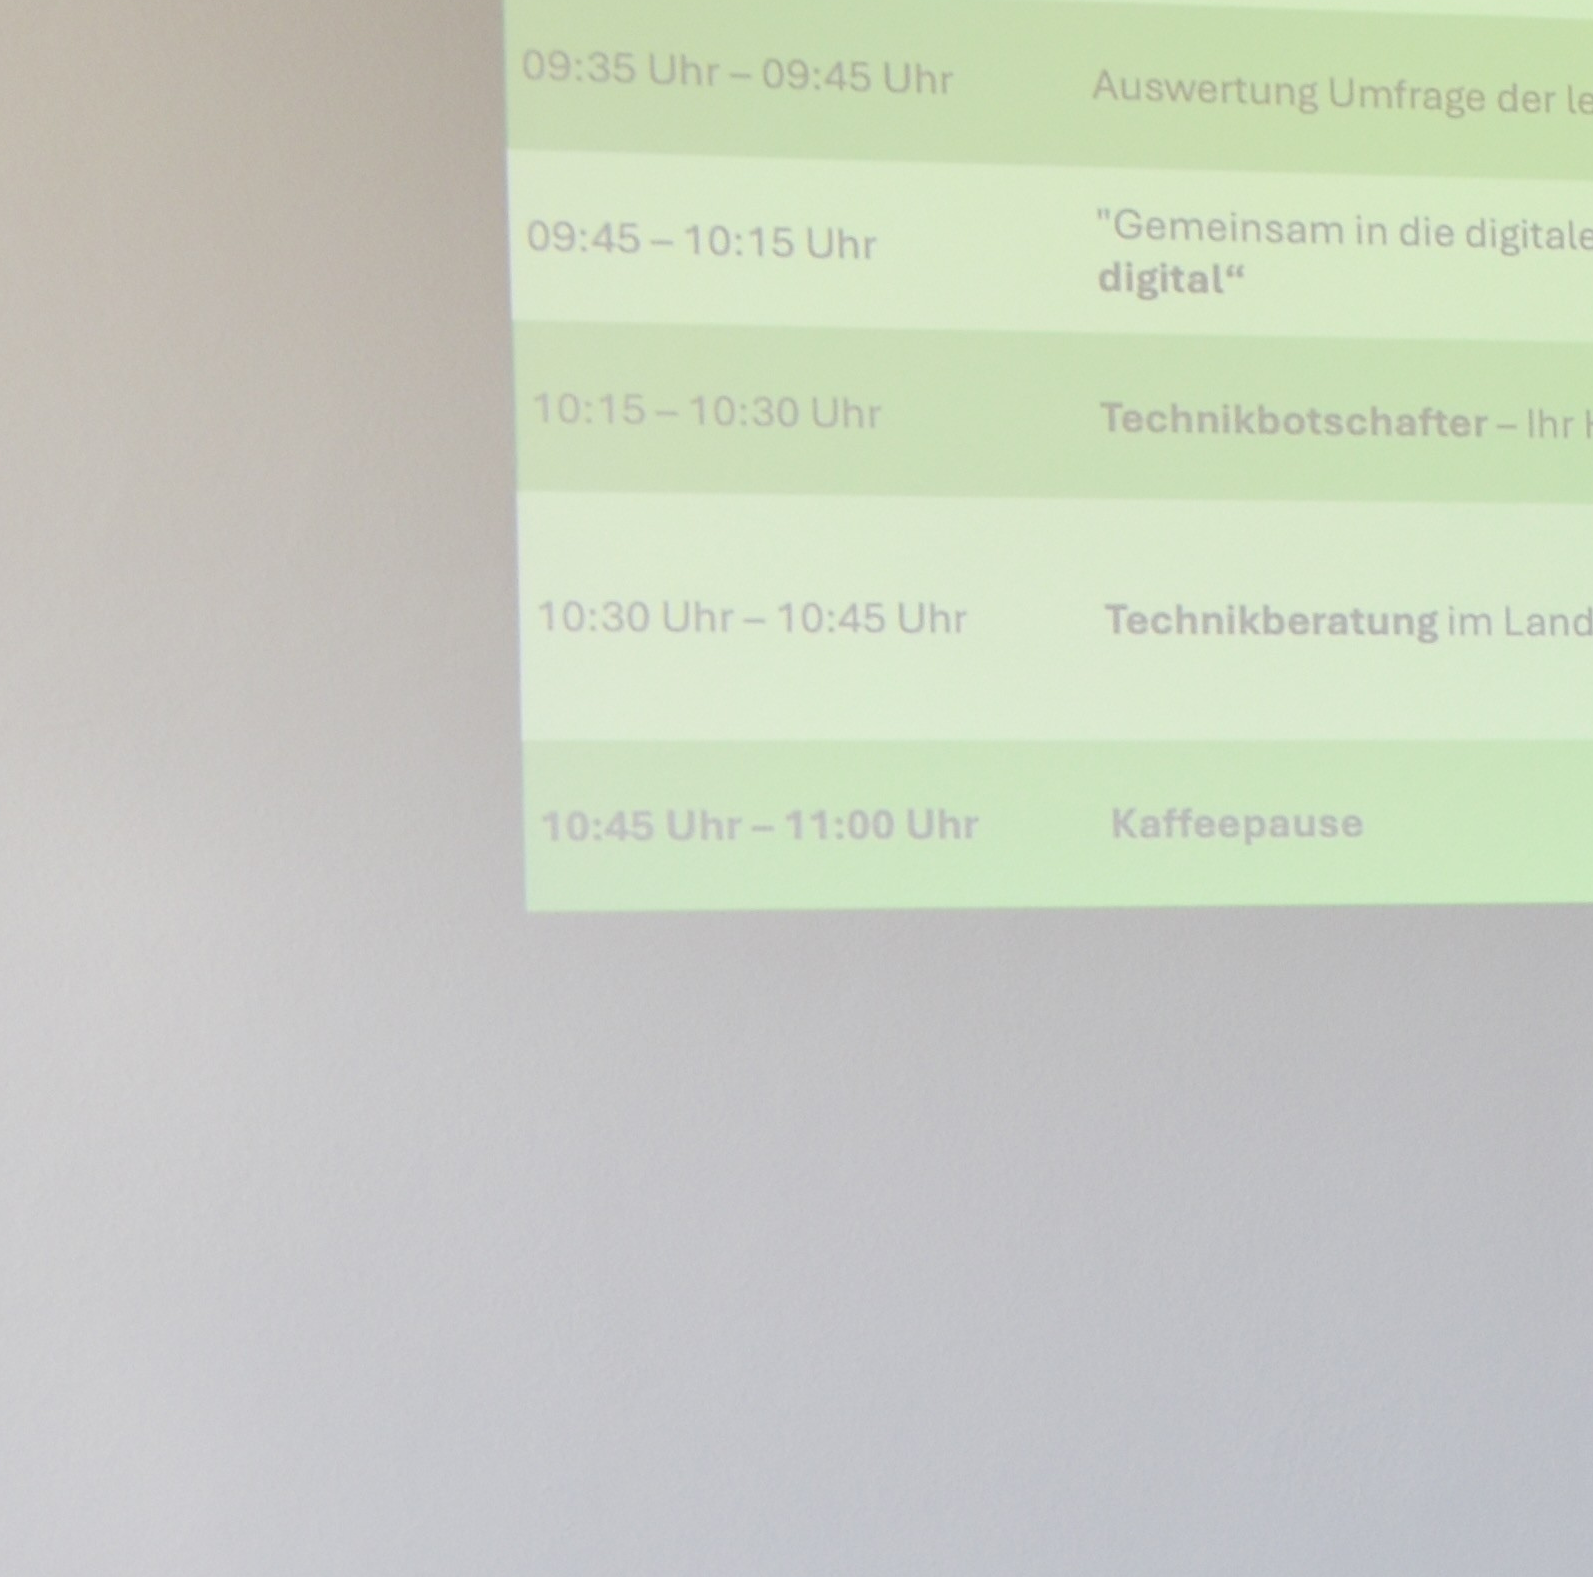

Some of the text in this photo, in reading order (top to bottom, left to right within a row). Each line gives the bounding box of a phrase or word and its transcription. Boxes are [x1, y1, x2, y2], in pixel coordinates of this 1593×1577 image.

[523, 49, 636, 83] 09:35
[649, 53, 719, 86] Uhr
[763, 58, 871, 92] 09:45
[884, 62, 953, 94] Uhr
[1092, 69, 1319, 114] Auswertung
[1329, 77, 1485, 119] Umfrage
[1497, 83, 1556, 113] der
[528, 220, 640, 254] 09:45
[686, 225, 794, 258] 10:15
[807, 227, 876, 259] Uhr
[1356, 215, 1387, 245] in
[1399, 216, 1454, 247] die
[534, 393, 646, 425] 10:15
[691, 395, 799, 428] 10:30
[812, 397, 881, 428] Uhr
[1100, 402, 1488, 437] Technikbotschafter
[1528, 408, 1574, 438] Ihr
[539, 600, 650, 632] 10:30
[663, 601, 734, 633] Uhr
[779, 602, 885, 633] 10:45
[898, 602, 967, 634] Uhr
[1105, 604, 1438, 644] Technikberatung
[1449, 606, 1492, 635] im
[543, 810, 654, 841] 10:45
[667, 810, 742, 841] Uhr
[786, 809, 894, 840] 11:00
[907, 808, 979, 839] Uhr
[1113, 808, 1363, 846] Kaffeepause
